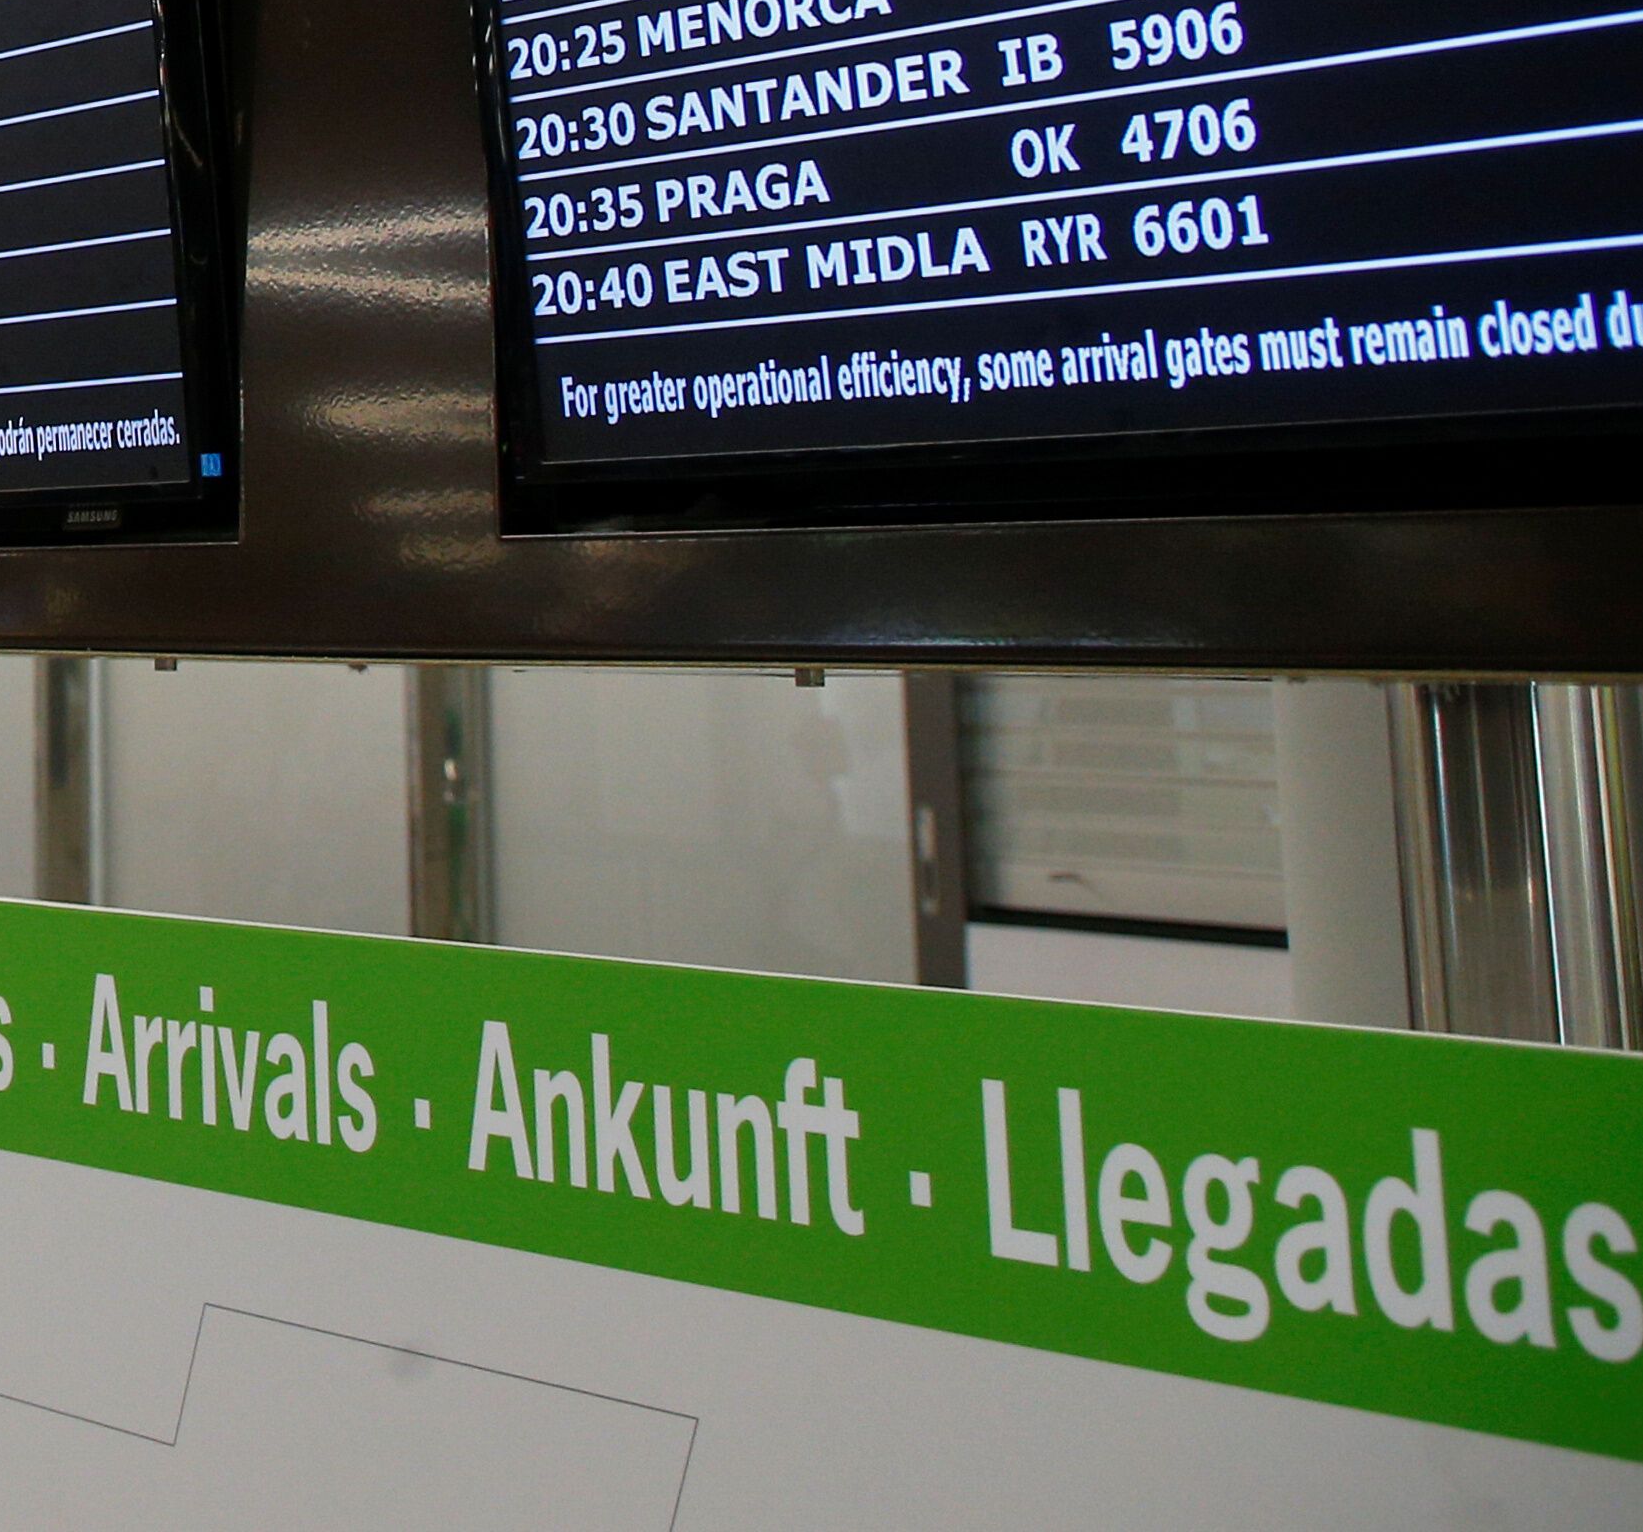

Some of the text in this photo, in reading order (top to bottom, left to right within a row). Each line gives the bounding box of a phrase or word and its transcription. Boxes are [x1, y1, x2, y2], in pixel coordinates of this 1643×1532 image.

[507, 20, 626, 80] 20:25
[524, 97, 1257, 239] 20:35 PRAGA OK 4706
[532, 194, 1270, 316] 20:40 EAST MIDLA RYR 6601
[561, 376, 599, 418] For
[603, 371, 687, 425] greater
[692, 355, 832, 418] operational
[837, 349, 972, 403] efficiency,
[977, 348, 1055, 391] some
[1060, 329, 1159, 385] arrival
[1164, 327, 1252, 389] gates
[1258, 317, 1345, 371] must
[1347, 305, 1473, 365] remain
[1476, 292, 1601, 358] closed
[36, 421, 114, 461] permanecer
[116, 408, 180, 449] cerradas.
[83, 974, 376, 1152] Arrivals
[469, 1021, 864, 1235] Ankunft
[982, 1079, 1643, 1360] Llegadas
